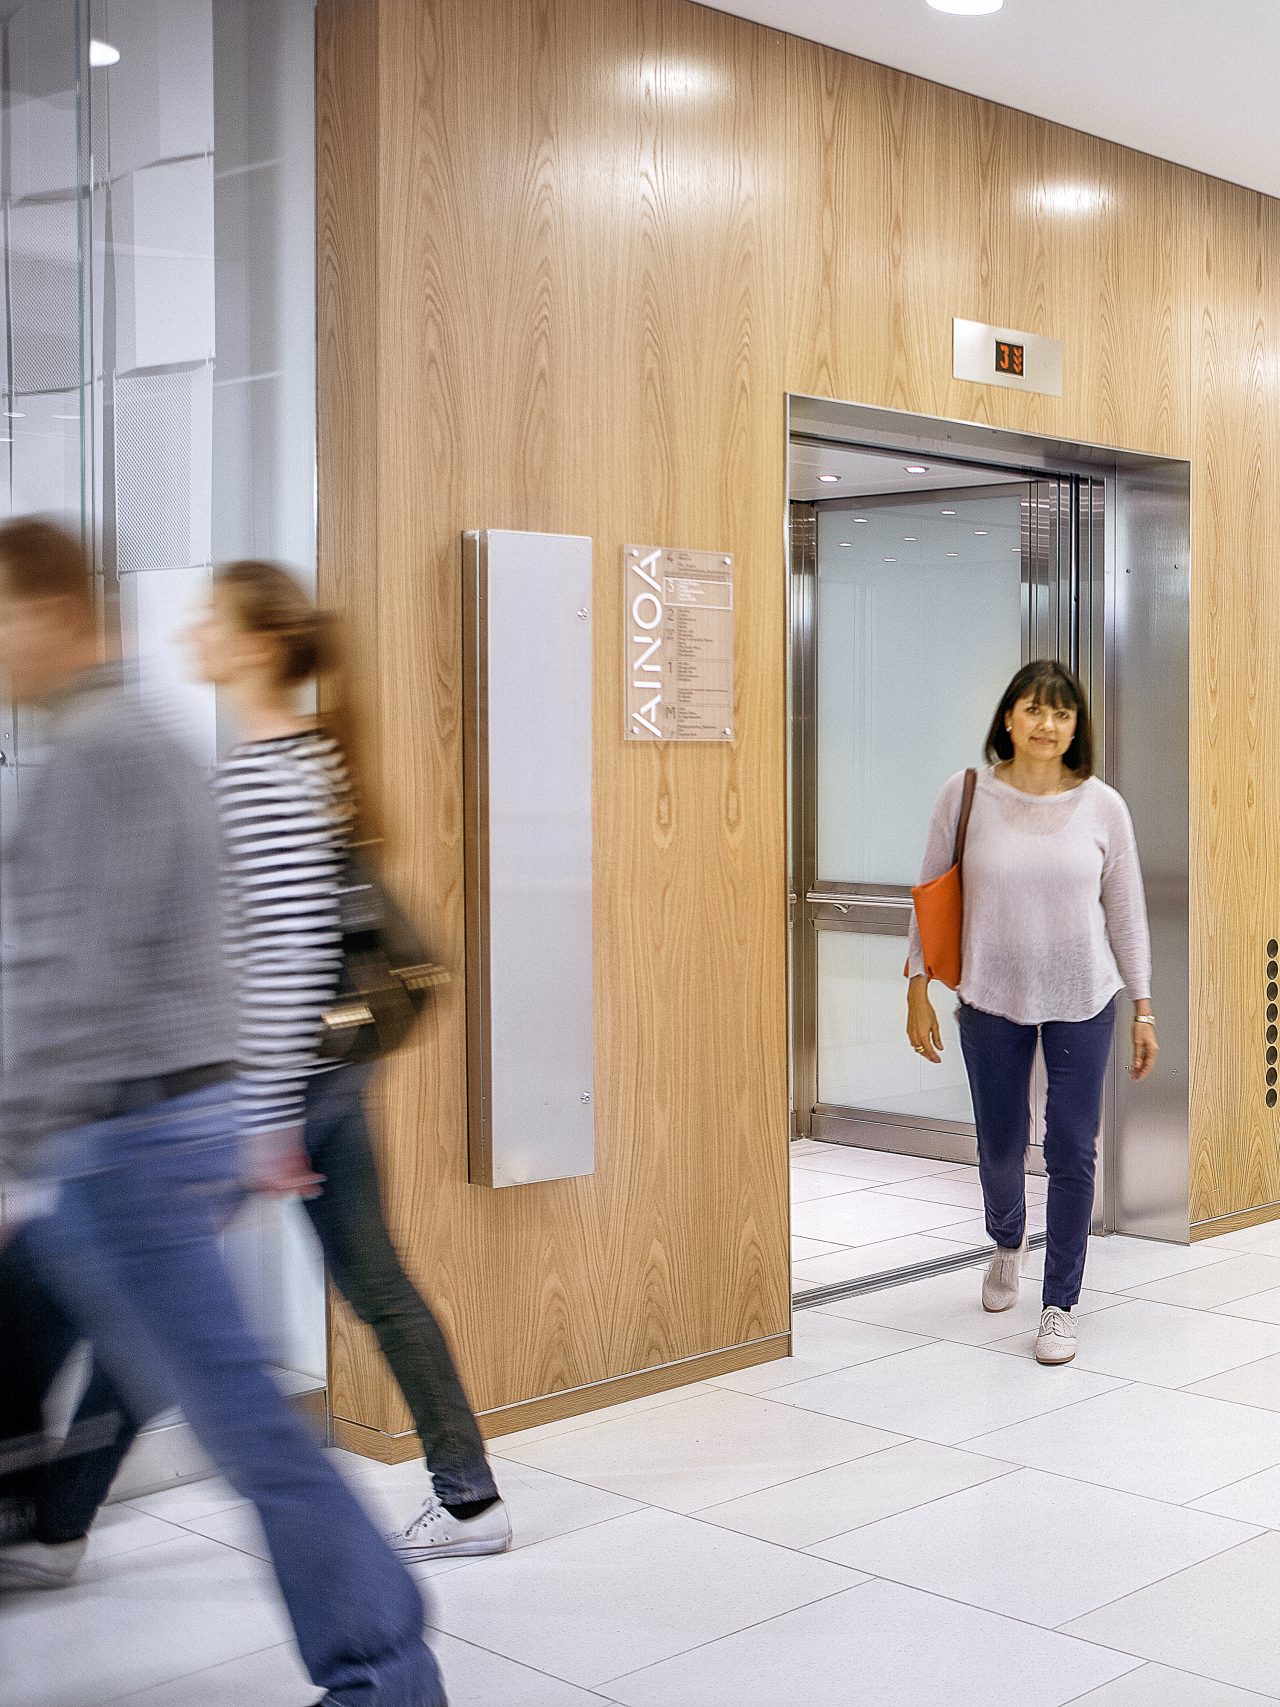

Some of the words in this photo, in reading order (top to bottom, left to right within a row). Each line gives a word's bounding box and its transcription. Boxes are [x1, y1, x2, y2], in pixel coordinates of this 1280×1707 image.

[667, 608, 675, 621] 2
[631, 549, 663, 738] AINOA
[667, 661, 673, 674] 1
[665, 706, 677, 719] M
